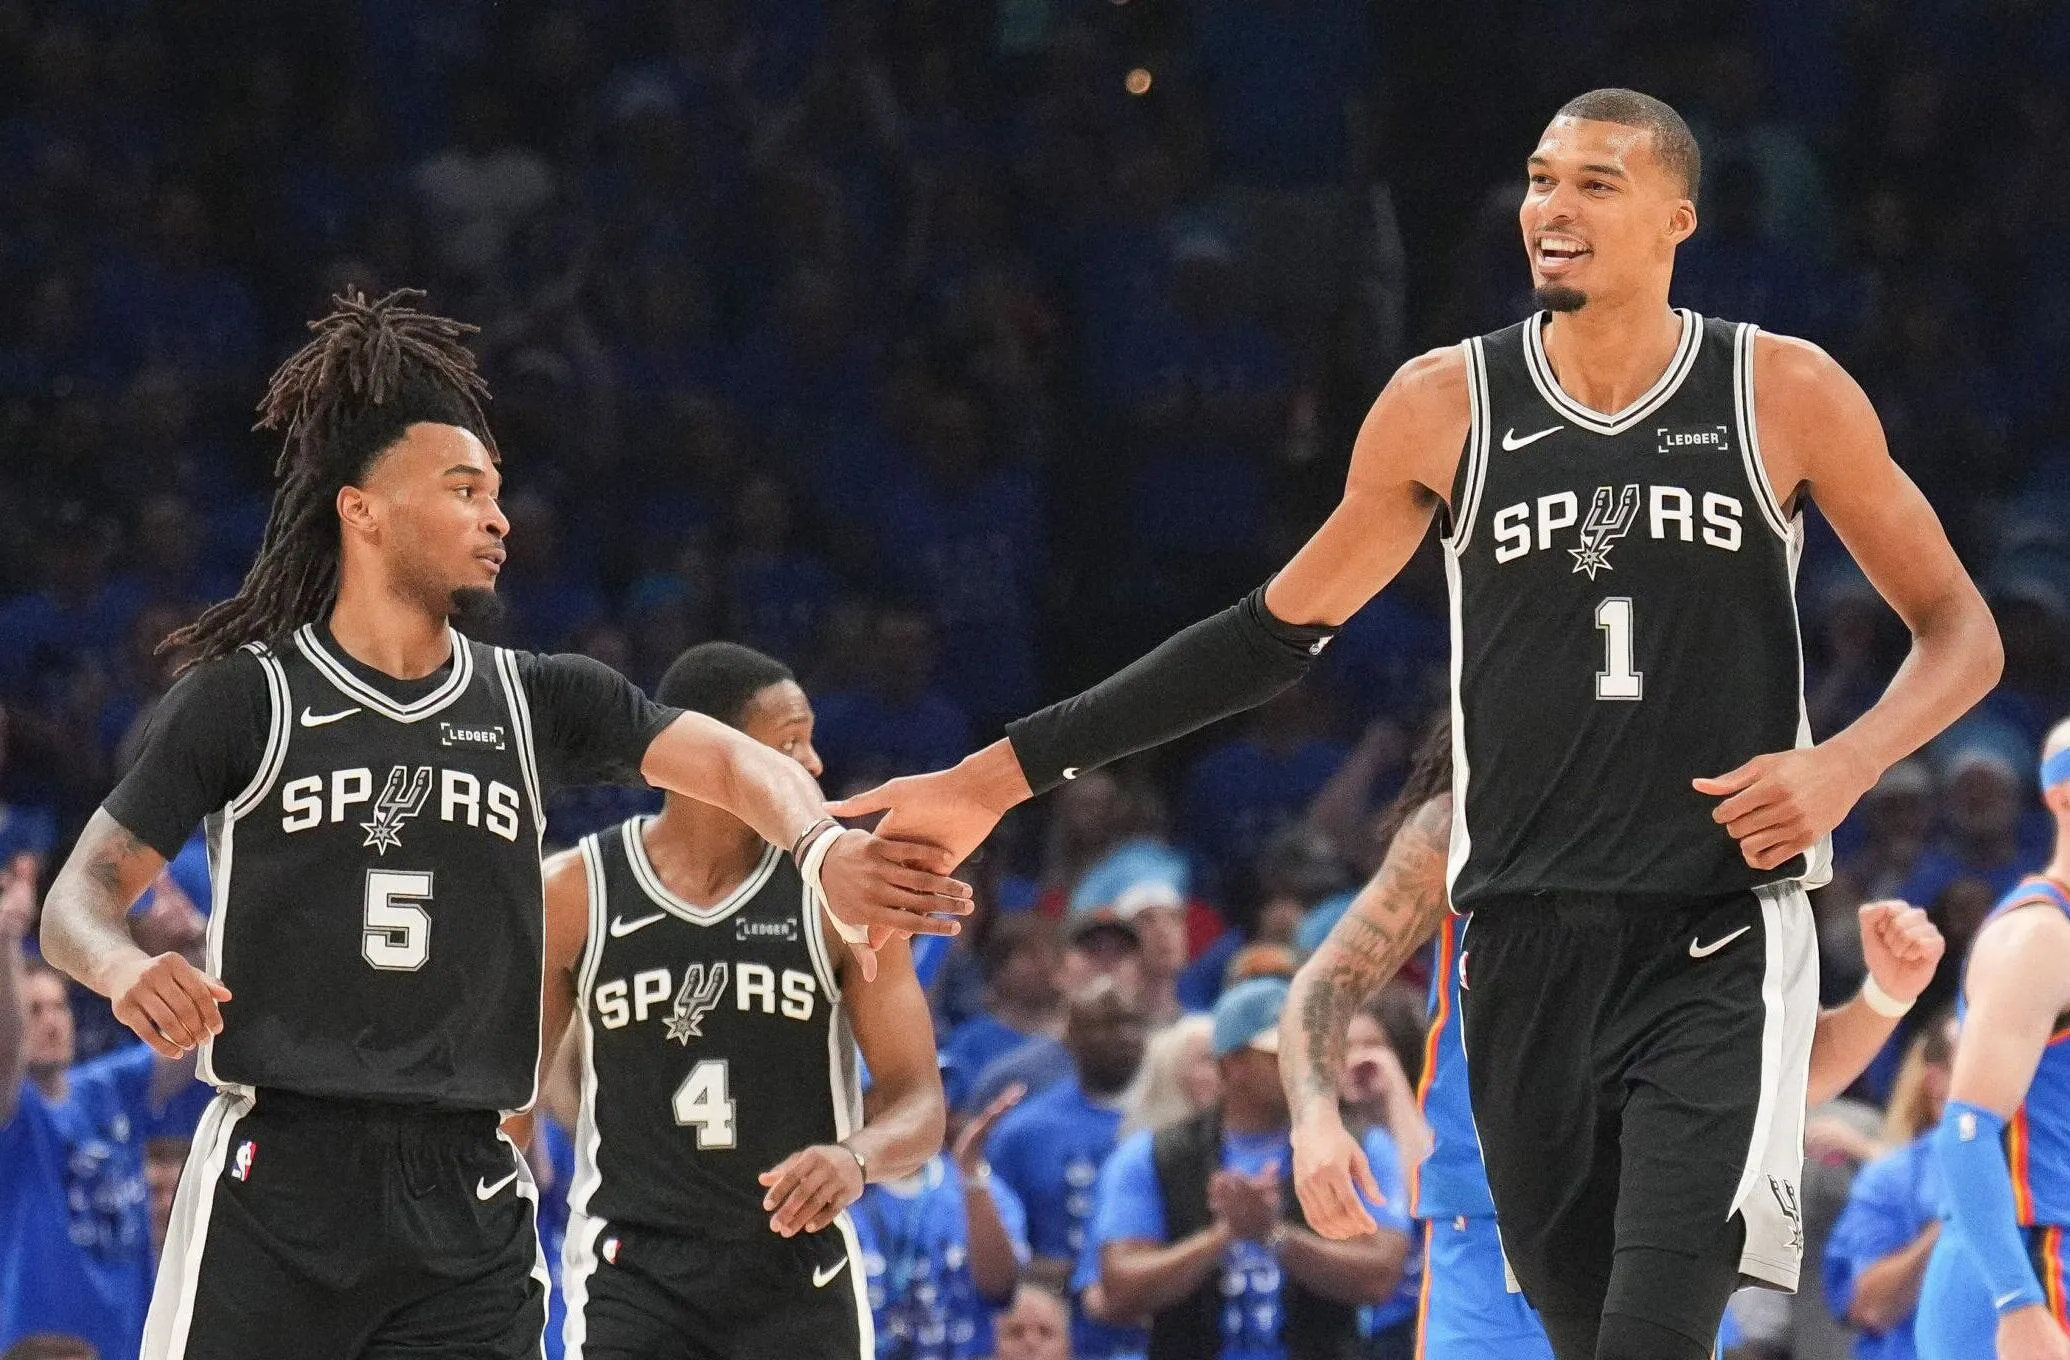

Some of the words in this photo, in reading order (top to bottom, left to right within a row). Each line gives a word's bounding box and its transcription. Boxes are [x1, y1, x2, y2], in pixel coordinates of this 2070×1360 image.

[1667, 433, 1719, 446] LEDGER
[1494, 484, 1743, 581] SPURS
[1595, 597, 1643, 701] 1
[450, 729, 497, 743] LEDGER
[282, 766, 520, 856] SPURS
[362, 869, 434, 972] 5
[596, 963, 816, 1047] SPURS
[672, 1060, 737, 1150] 4
